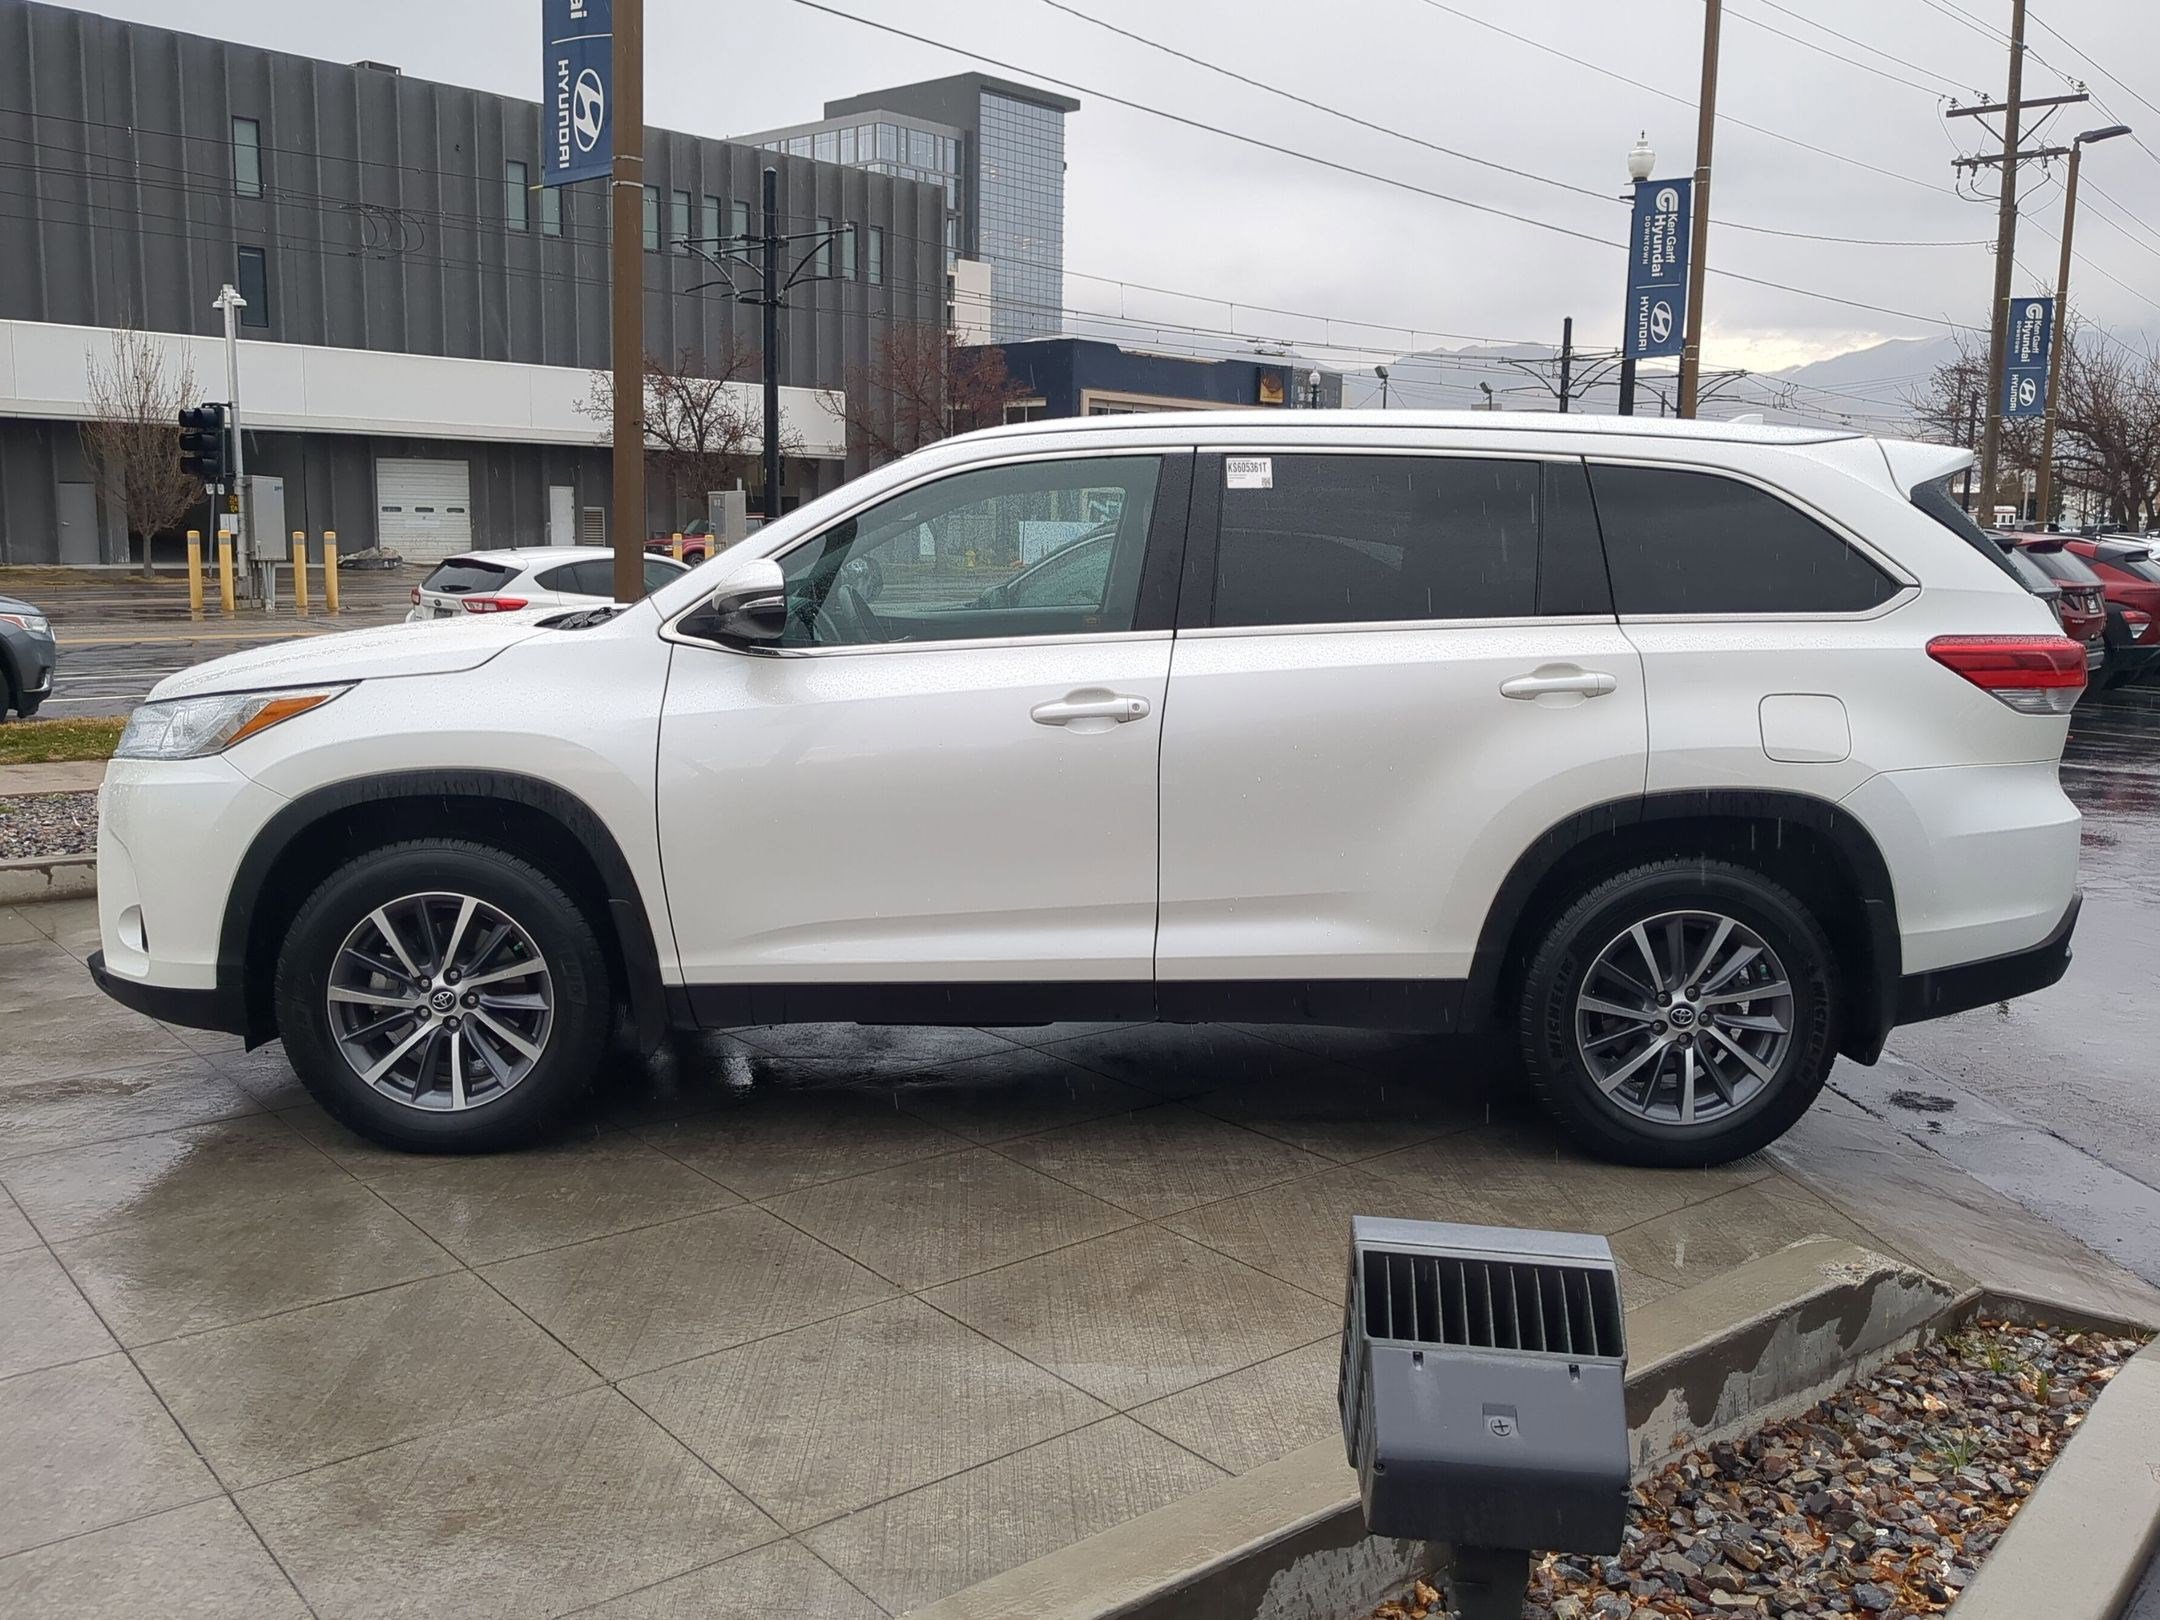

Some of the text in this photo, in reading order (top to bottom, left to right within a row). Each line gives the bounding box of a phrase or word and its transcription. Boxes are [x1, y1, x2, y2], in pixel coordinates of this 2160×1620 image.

[558, 59, 570, 169] HYUNDAI
[1642, 215, 1651, 265] DOWNTOWN
[1651, 214, 1666, 278] Hyundai
[1665, 213, 1678, 264] Ken Garff
[1638, 296, 1649, 351] HYUNDAI
[2020, 320, 2034, 363] Hyundai
[2032, 320, 2042, 354] Ken Garff
[2009, 373, 2019, 412] HYUNDAI
